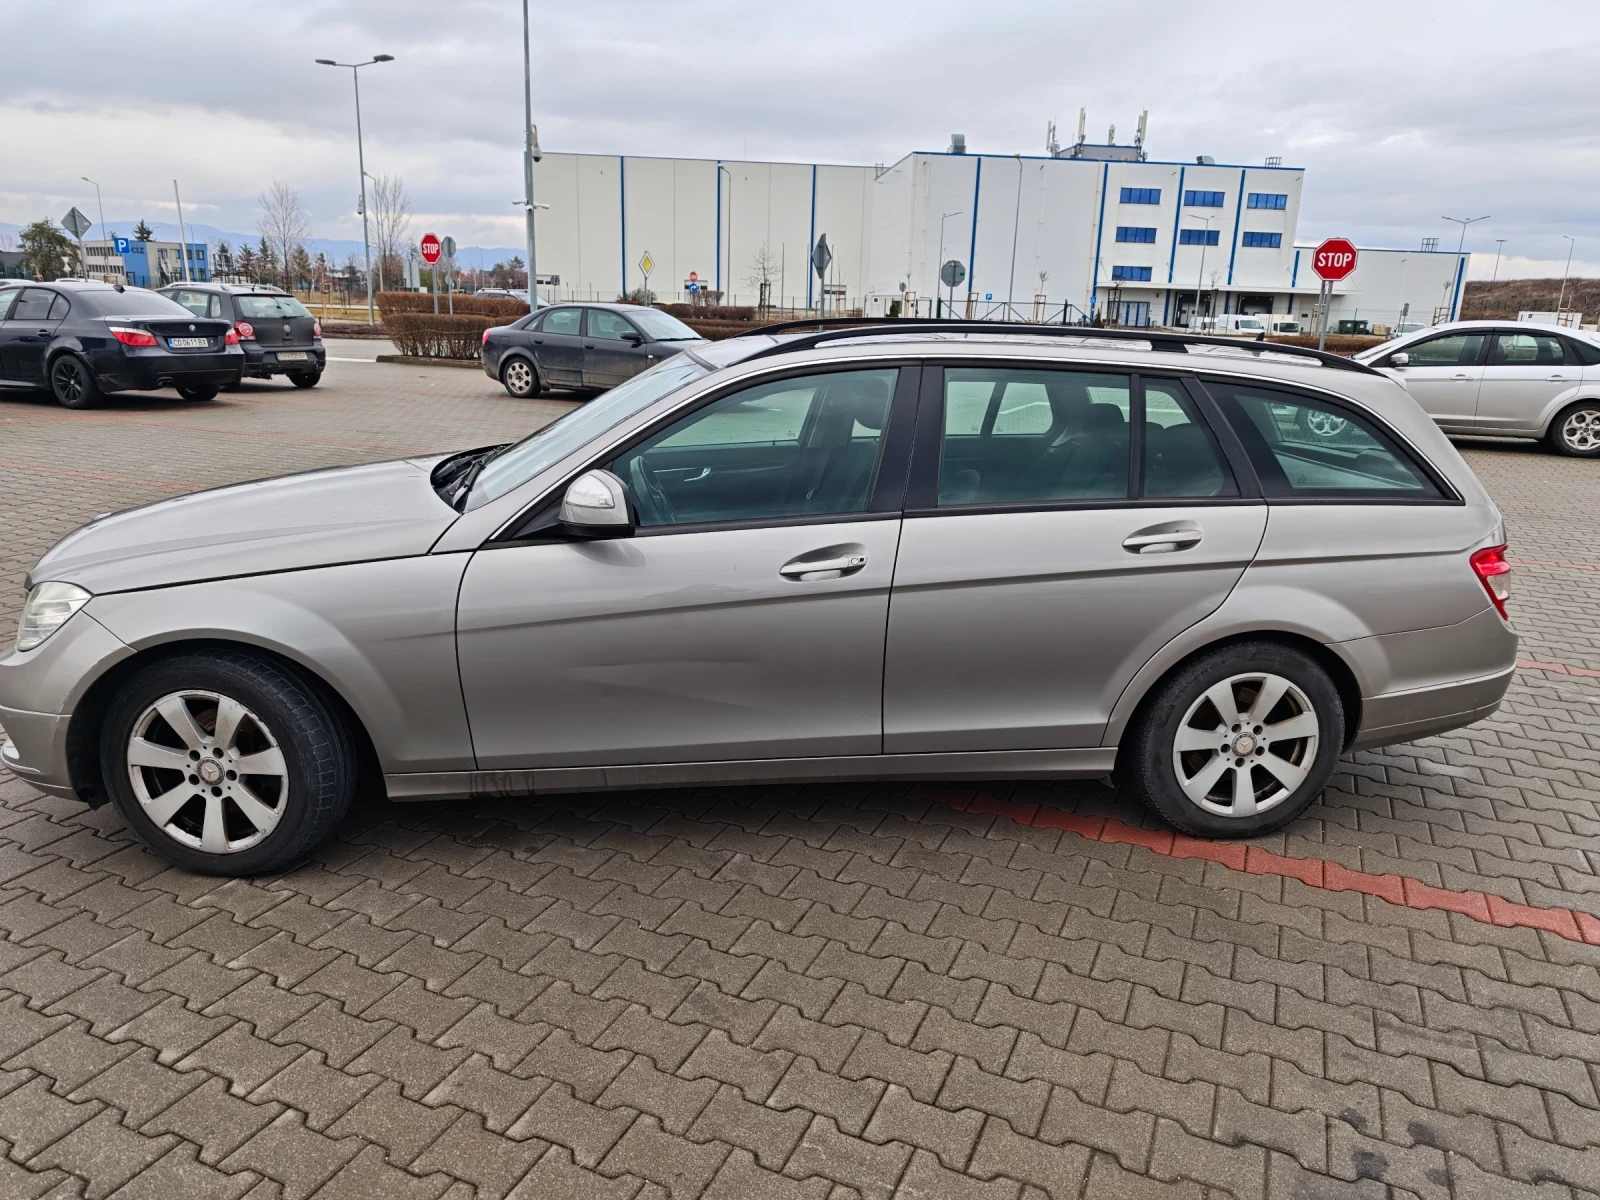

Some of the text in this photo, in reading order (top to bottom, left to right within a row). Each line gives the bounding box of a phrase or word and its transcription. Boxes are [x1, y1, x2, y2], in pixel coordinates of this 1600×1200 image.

[118, 239, 127, 252] P
[422, 243, 439, 255] STOP
[1317, 252, 1353, 268] STOP
